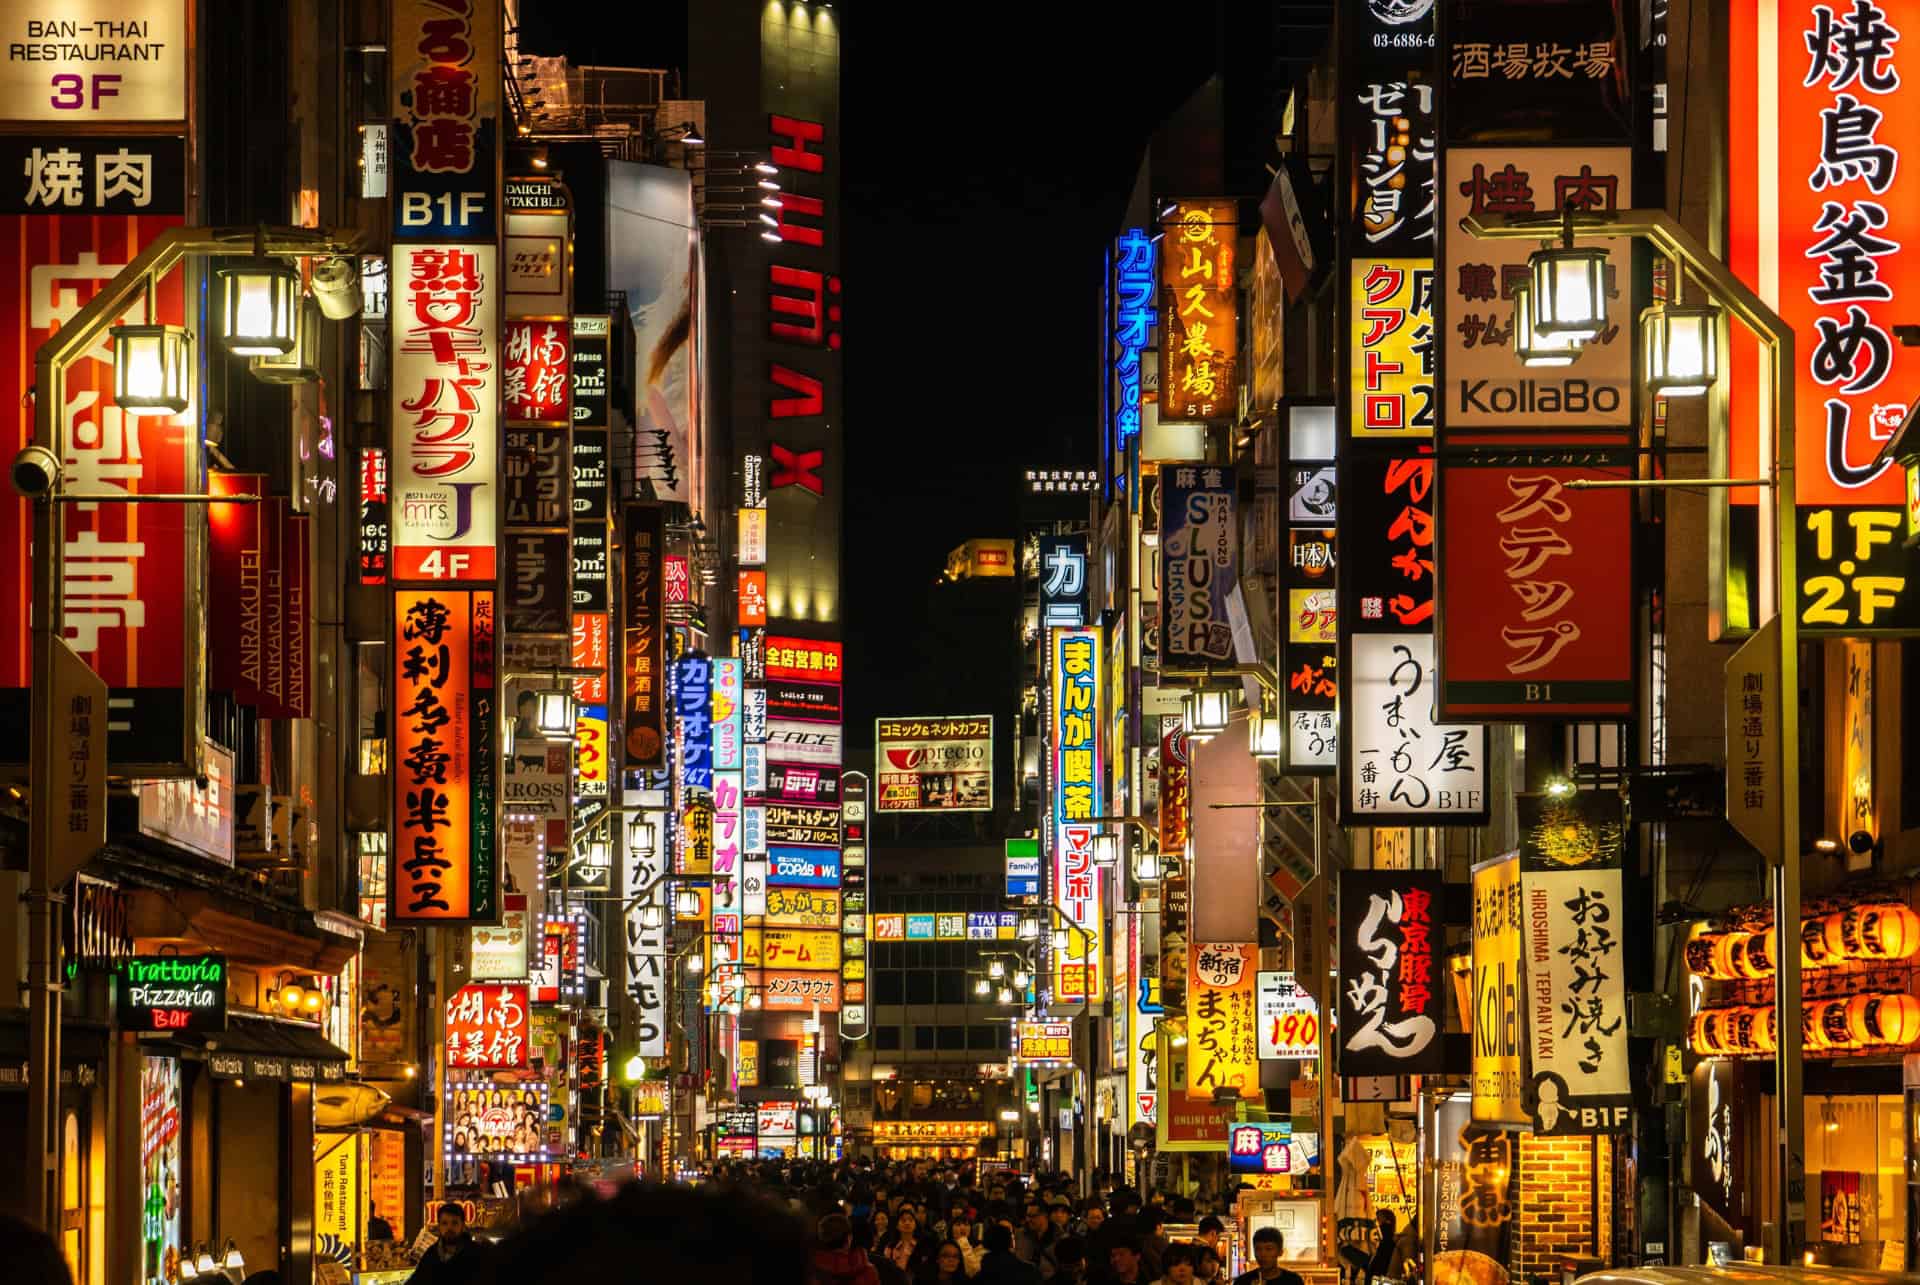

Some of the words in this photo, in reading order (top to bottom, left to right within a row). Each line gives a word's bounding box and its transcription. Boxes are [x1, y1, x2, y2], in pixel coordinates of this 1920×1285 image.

[10, 44, 163, 61] RESTAURANT
[28, 21, 148, 38] BAN-THAI
[1452, 42, 1612, 79] 酒場牧場
[51, 74, 122, 110] 3F
[24, 148, 152, 208] 焼肉
[401, 191, 485, 226] B1F
[1803, 0, 1900, 488] 焼鳥釜めし
[1180, 247, 1217, 397] 山久農場
[1362, 264, 1405, 430] クアトロ
[399, 248, 492, 479] 熟女キャバクラ
[1186, 404, 1214, 416] 5F
[1460, 379, 1621, 413] KollaBo
[507, 434, 528, 447] 3F
[536, 432, 559, 522] レンタル
[1175, 467, 1222, 488] 麻雀
[1806, 509, 1902, 560] 1F
[418, 550, 471, 579] 4F
[516, 538, 545, 605] エデン
[1495, 473, 1581, 675] ステップ
[241, 549, 258, 682] ANRAKUTEI
[1801, 575, 1906, 625] 2F
[766, 649, 838, 671] 全店営業中
[682, 659, 708, 765] カラオケ
[754, 688, 766, 736] カラオケ
[1525, 684, 1552, 700] B1
[1063, 640, 1092, 819] まんが喫茶
[1382, 644, 1430, 809] うまいもん
[1742, 671, 1765, 809] 劇場通り一番街
[1358, 748, 1380, 809] 一番街
[1437, 790, 1481, 809] B1F
[693, 811, 709, 861] 麻雀
[1067, 828, 1091, 922] マンボー
[977, 915, 997, 928] TAX
[1531, 888, 1549, 962] HIROSHIMA
[129, 959, 221, 982] Trattoria
[765, 943, 812, 961] ゲーム
[1399, 887, 1432, 1014] 東京豚骨
[131, 985, 215, 1006] Pizzeria
[768, 979, 834, 994] メンズサウナ
[1558, 886, 1622, 1074] お好み焼き
[152, 1008, 192, 1027] Bar
[1196, 989, 1228, 1087] まっちゃん
[1270, 1013, 1319, 1045] 190
[1535, 971, 1554, 1060] TEPPANYAKI
[760, 1118, 795, 1130] ゲーム
[1581, 1106, 1629, 1128] B1F
[338, 1180, 348, 1231] Restaurant
